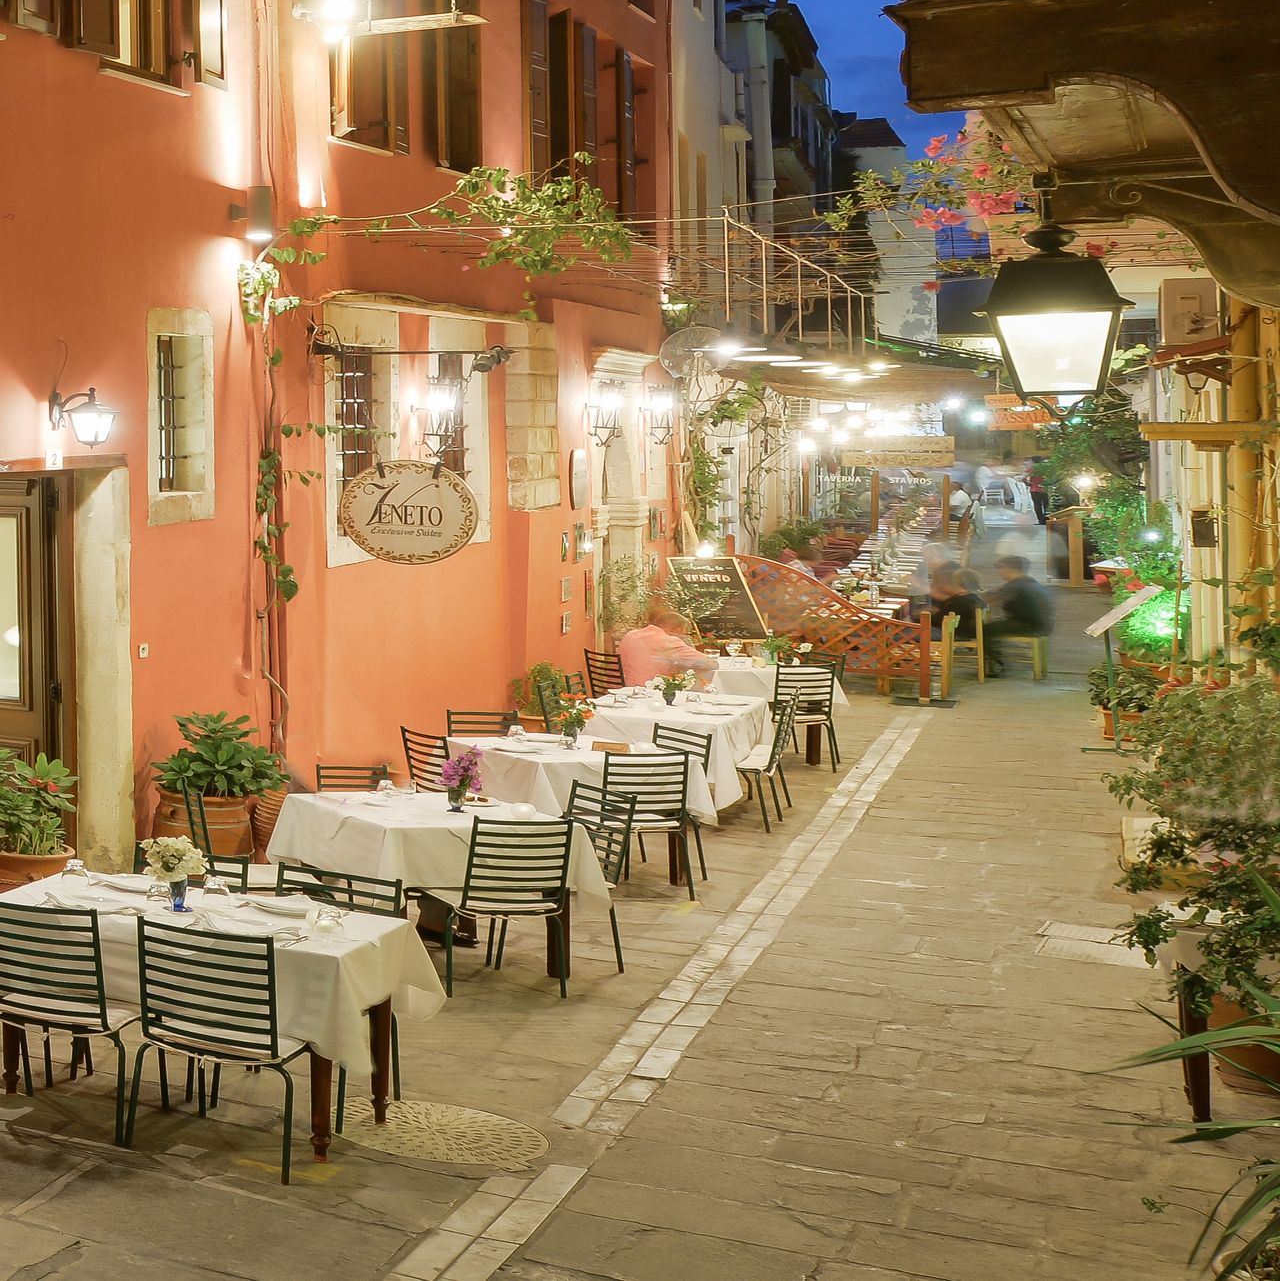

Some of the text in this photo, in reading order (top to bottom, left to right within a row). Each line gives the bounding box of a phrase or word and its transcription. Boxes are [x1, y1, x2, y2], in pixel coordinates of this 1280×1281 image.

[51, 453, 58, 466] 2
[819, 474, 933, 485] TAVERNA STAVROS
[362, 480, 443, 527] VENETO
[370, 526, 443, 538] Exclusive Suites
